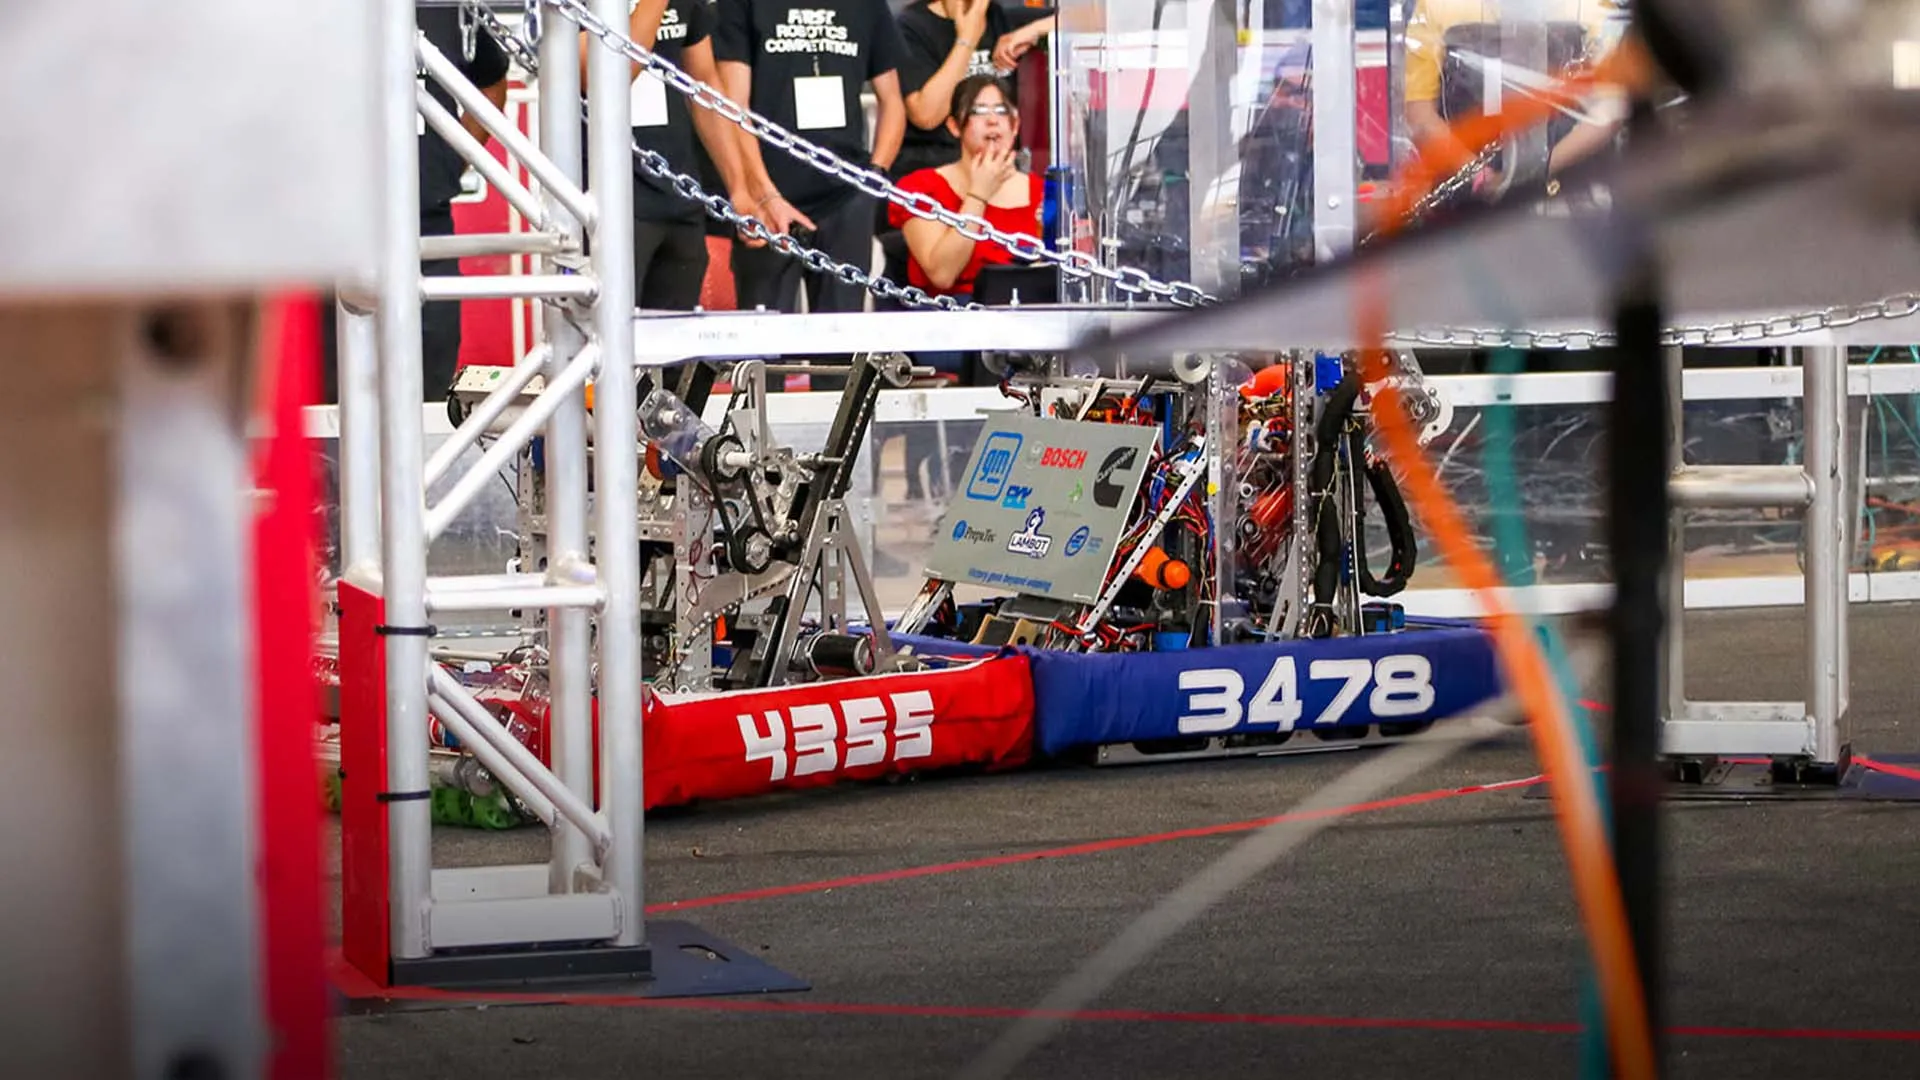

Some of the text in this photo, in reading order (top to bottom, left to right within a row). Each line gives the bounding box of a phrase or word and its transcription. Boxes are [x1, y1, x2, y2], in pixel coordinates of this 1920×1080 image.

[787, 9, 836, 25] FIRST
[775, 24, 848, 40] ROBOTICS
[764, 38, 859, 57] COMPETITION
[980, 449, 1010, 482] gm
[1041, 447, 1087, 470] BOSCH
[1011, 536, 1048, 550] LAMBOT
[1178, 654, 1436, 734] 3478
[736, 690, 934, 781] 4355
